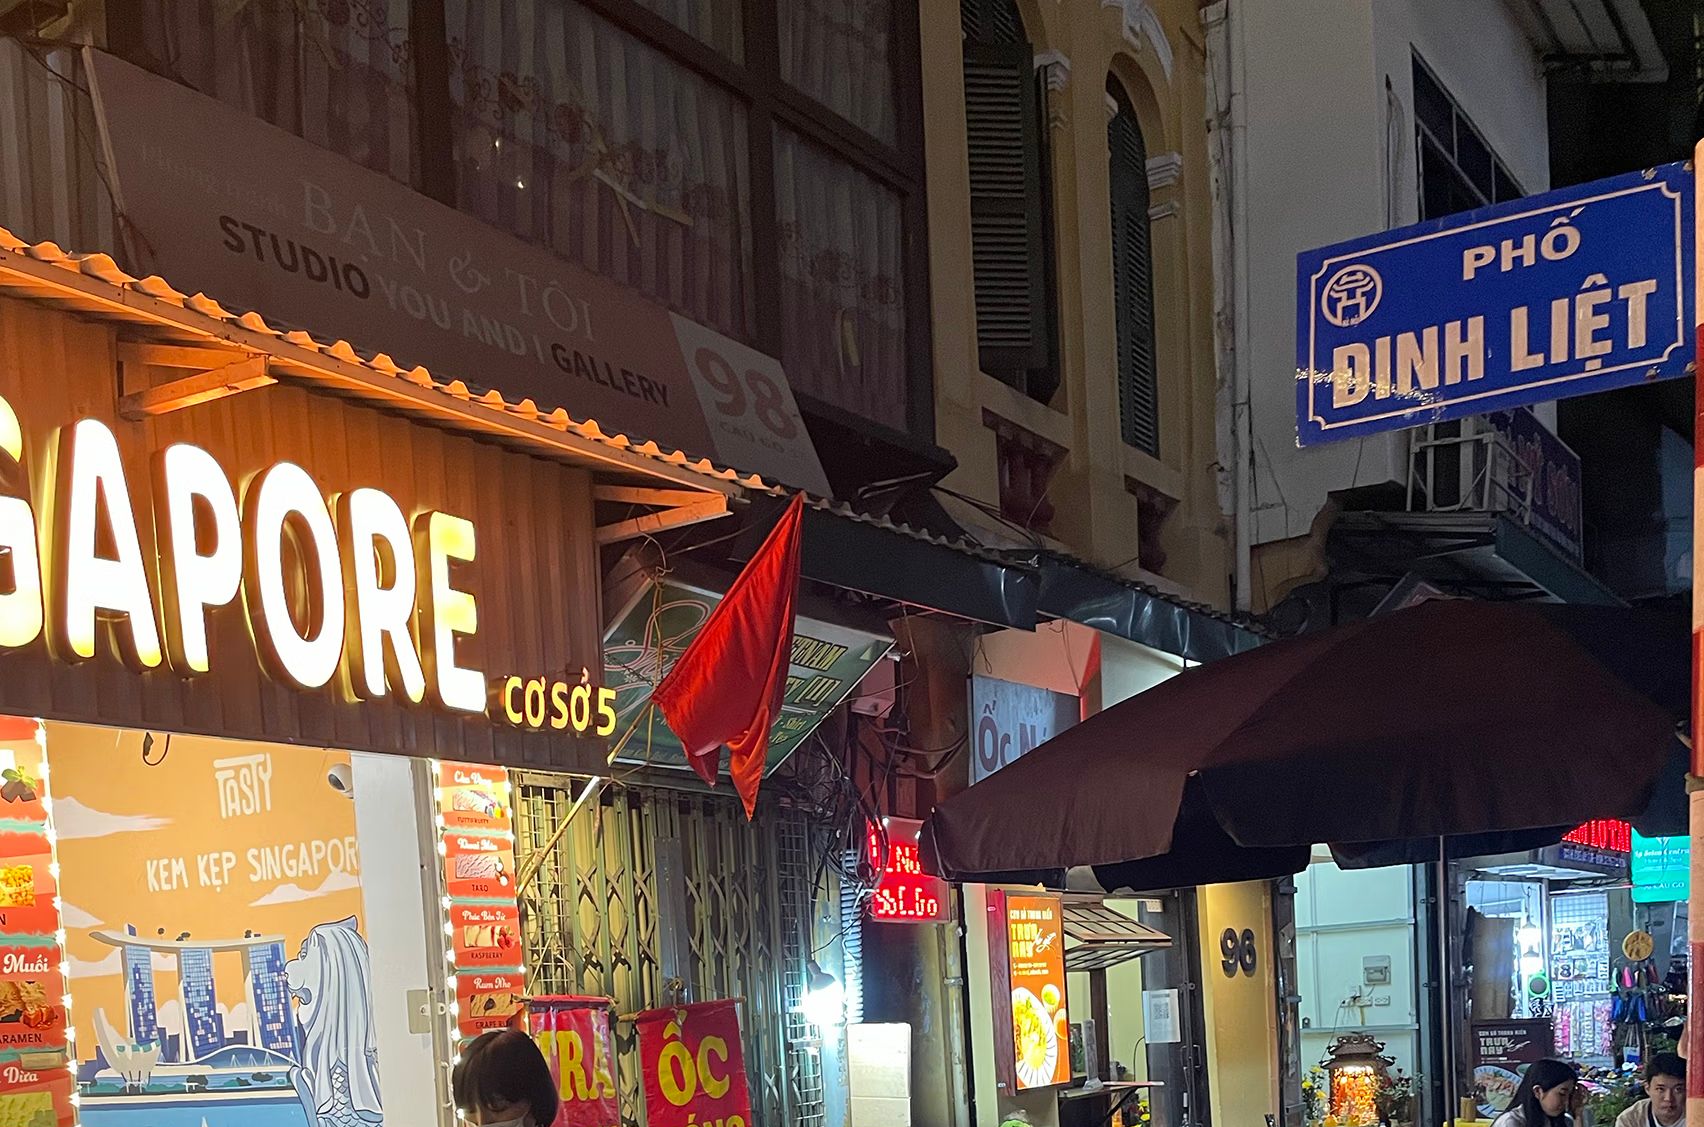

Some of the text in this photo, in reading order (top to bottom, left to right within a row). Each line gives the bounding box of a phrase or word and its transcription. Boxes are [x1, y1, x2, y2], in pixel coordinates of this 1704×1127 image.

[1463, 206, 1585, 281] PHỐ
[219, 215, 370, 300] STUDIO
[377, 272, 452, 330] YOU
[462, 308, 526, 355] AND
[550, 342, 669, 406] GALLERY
[1332, 272, 1657, 409] ĐINH LIỆT
[695, 347, 798, 440] 98
[505, 666, 618, 737] CƠ SỞ 5
[213, 752, 272, 820] TASTY
[146, 836, 360, 893] KEM KẸP SINGAPOR
[472, 884, 489, 892] TARO
[3, 953, 49, 974] Muối
[1220, 927, 1257, 978] 96
[658, 1009, 731, 1107] ỐC
